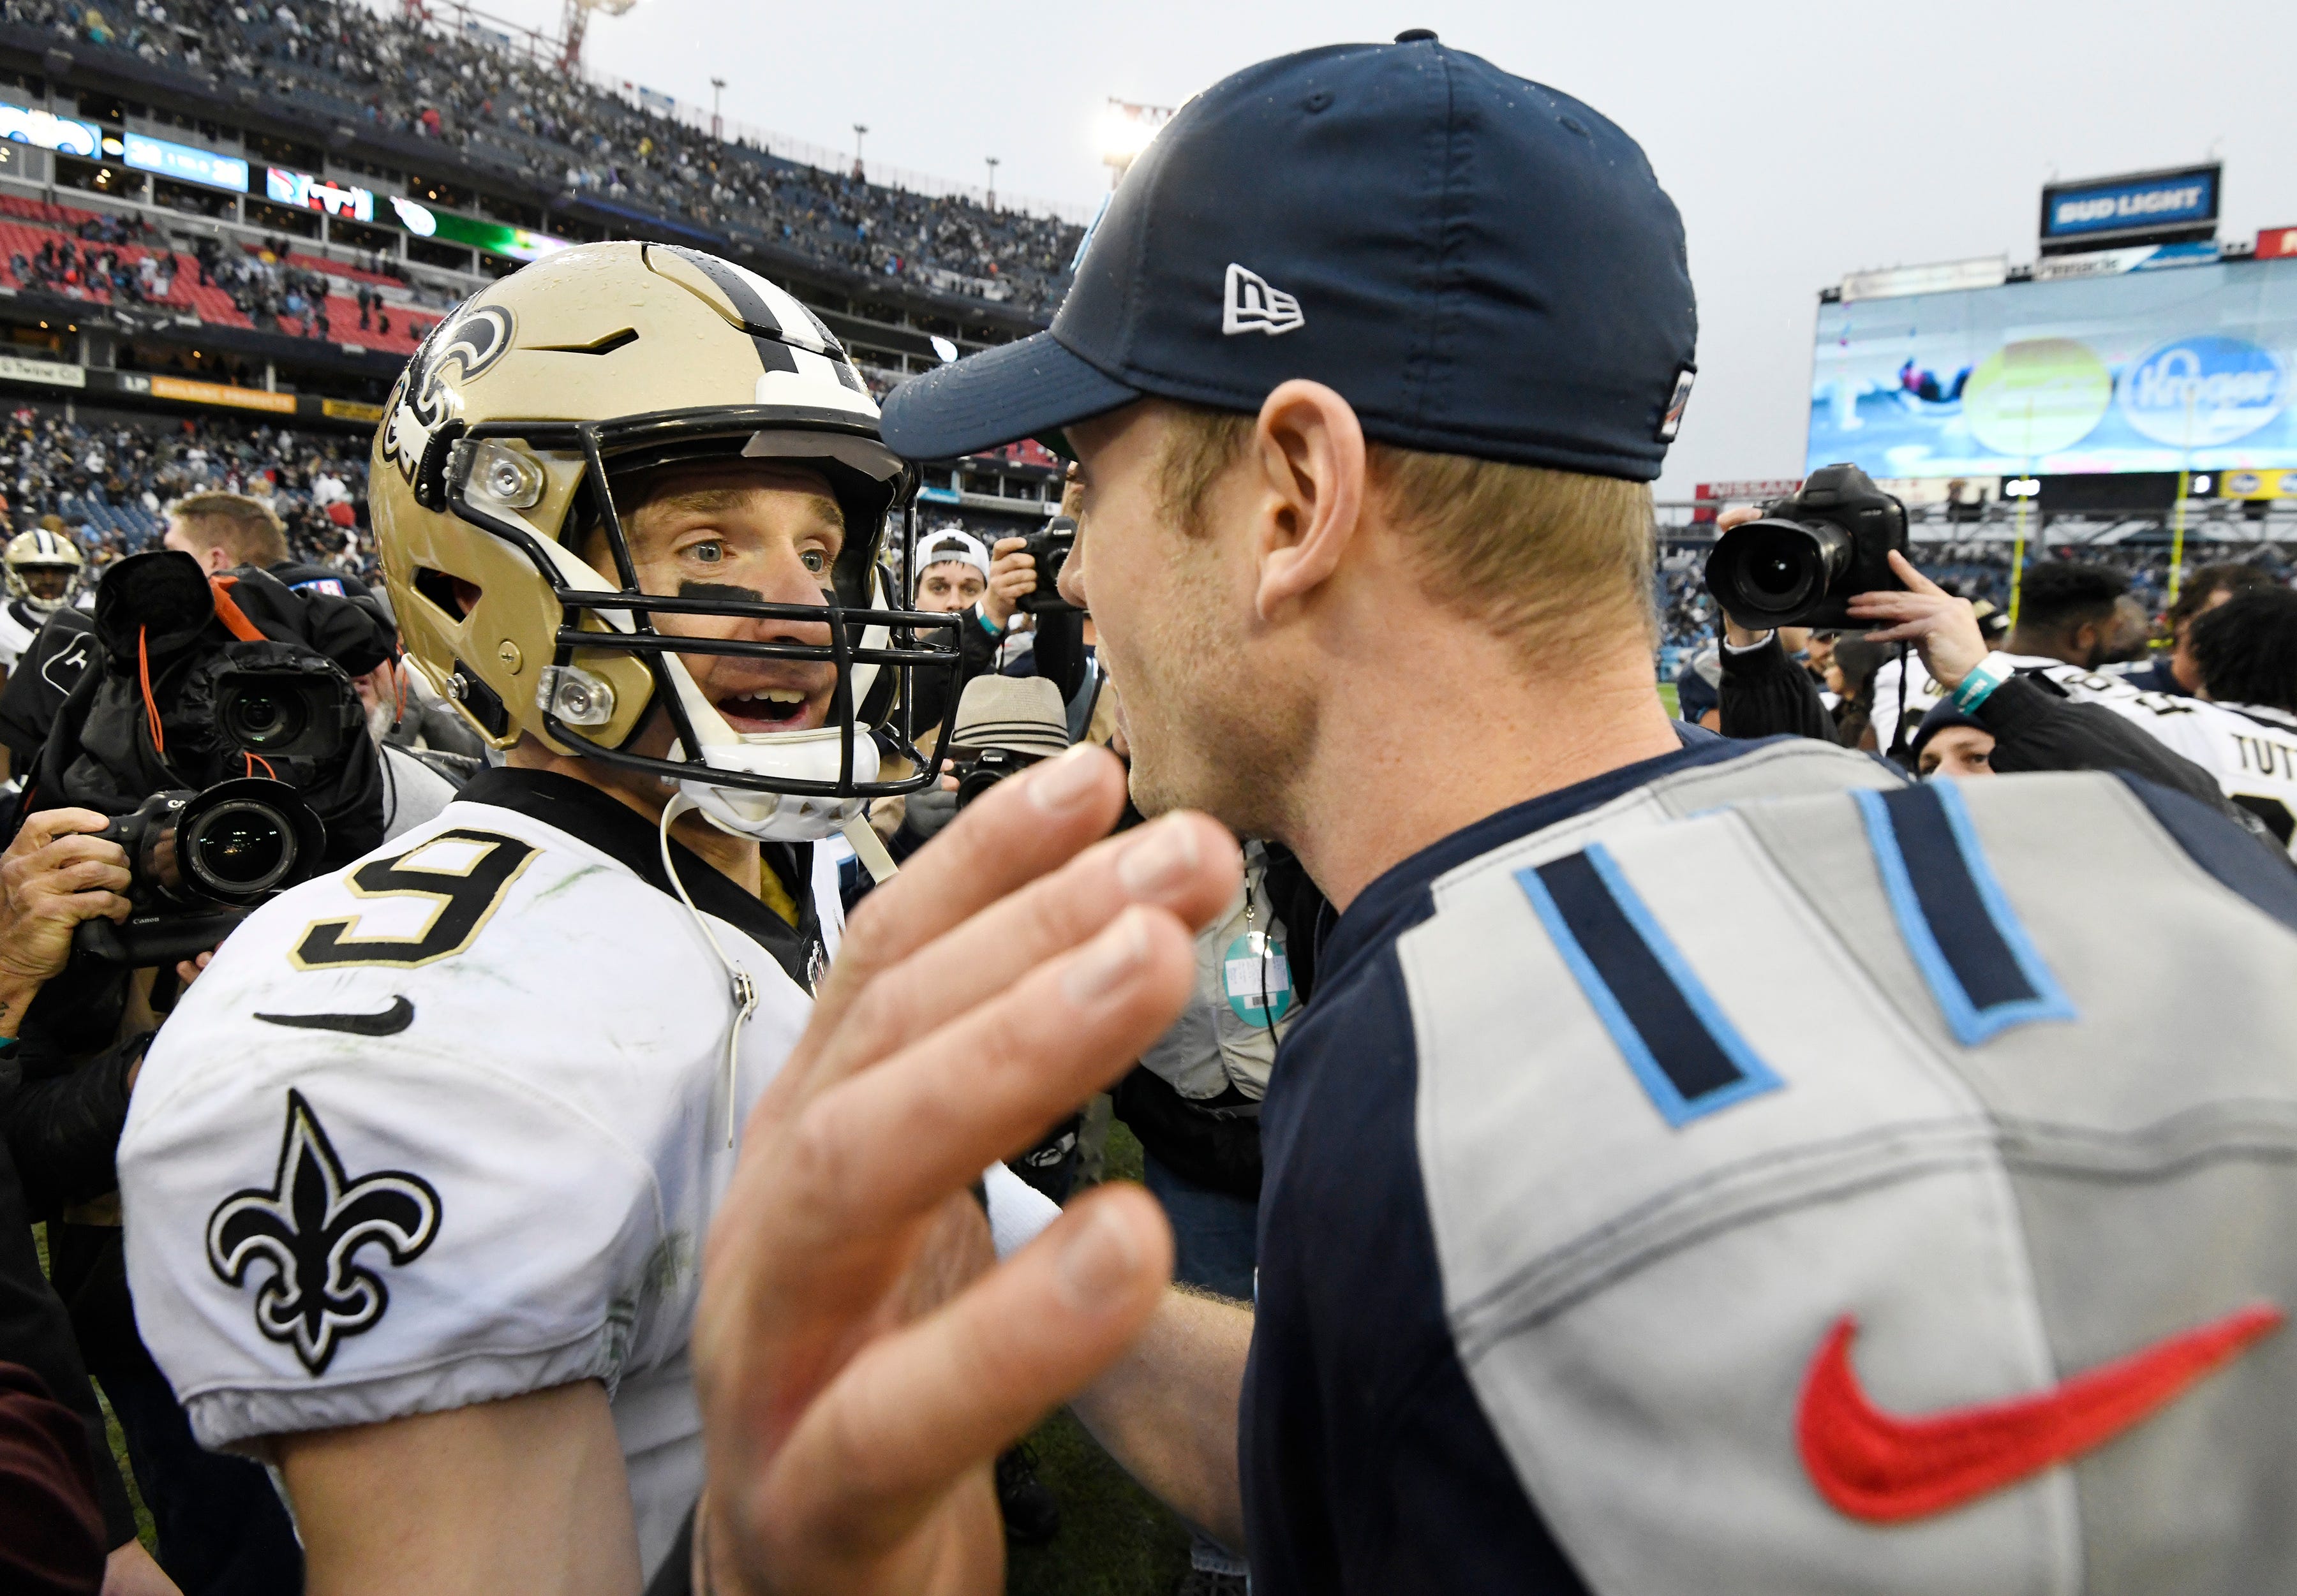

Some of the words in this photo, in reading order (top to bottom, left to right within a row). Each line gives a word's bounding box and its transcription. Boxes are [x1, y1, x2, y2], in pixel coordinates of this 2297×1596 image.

[2056, 198, 2116, 224] BUD
[2118, 186, 2202, 216] LIGHT
[2139, 348, 2275, 408] Kroger
[1708, 482, 1795, 499] NISSAN
[286, 826, 547, 972] 9
